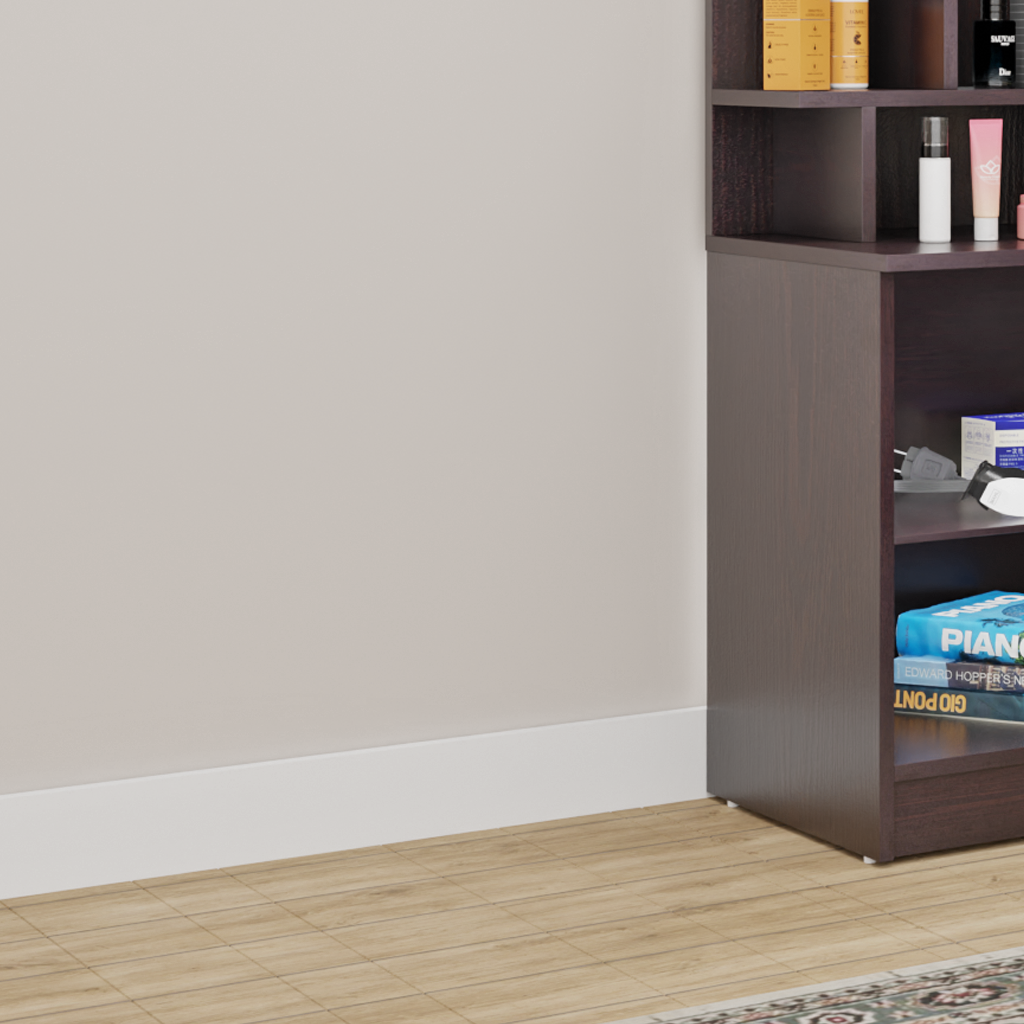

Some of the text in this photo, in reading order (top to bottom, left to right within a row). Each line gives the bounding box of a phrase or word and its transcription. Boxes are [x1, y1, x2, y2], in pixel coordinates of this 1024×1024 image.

[998, 67, 1012, 77] Dior
[905, 666, 953, 680] EDWARD
[955, 670, 1011, 686] HOPPER'S
[938, 692, 967, 714] GIO
